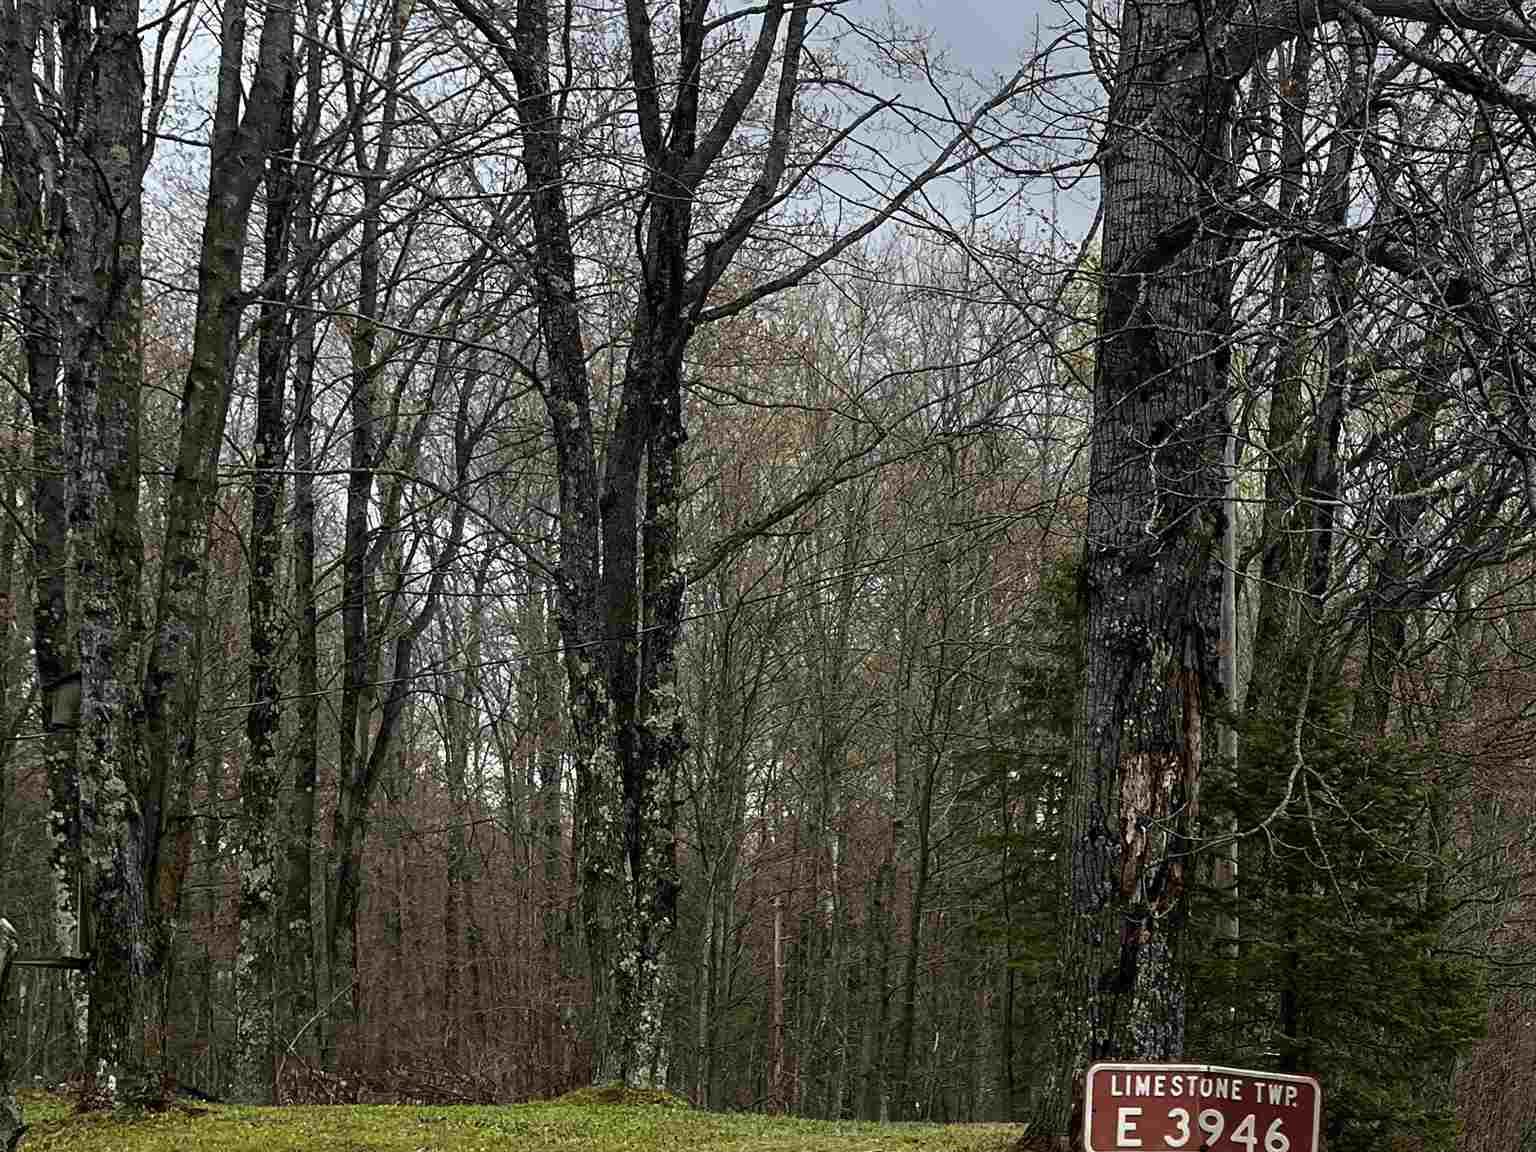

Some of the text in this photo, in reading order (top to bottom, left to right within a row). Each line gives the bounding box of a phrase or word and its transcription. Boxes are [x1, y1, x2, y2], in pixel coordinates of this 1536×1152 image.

[1112, 1075, 1298, 1107] LIMESTONE TWP.
[1116, 1107, 1142, 1147] E
